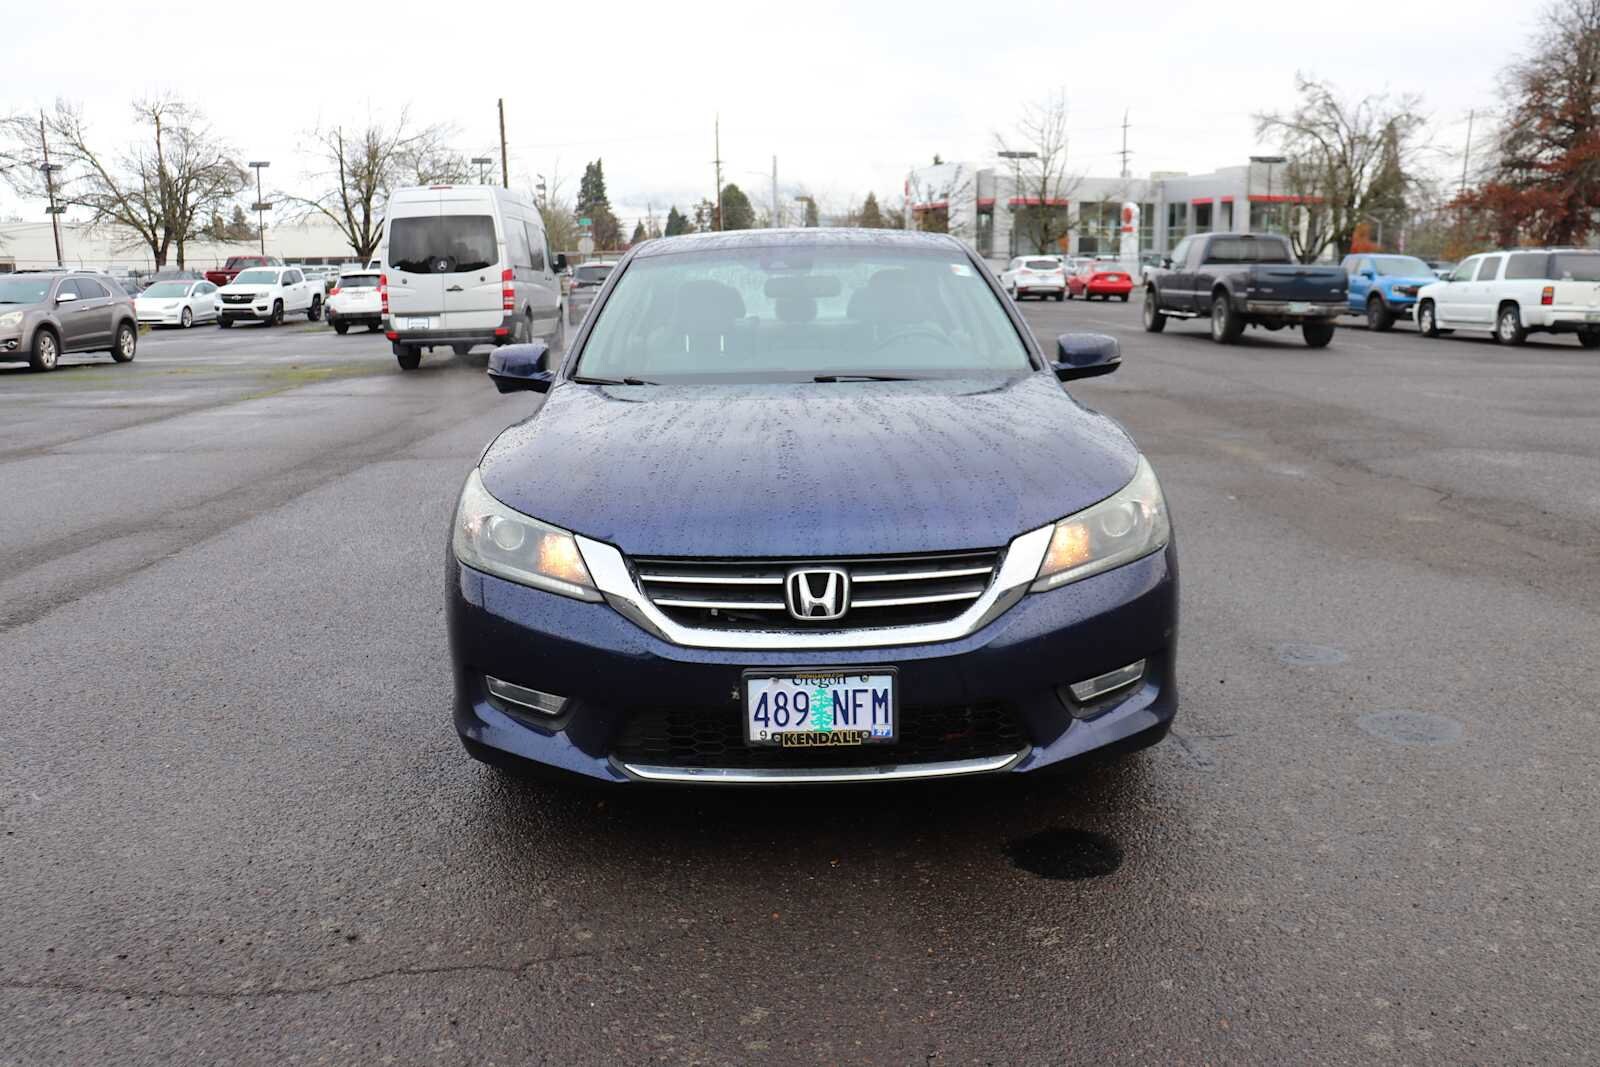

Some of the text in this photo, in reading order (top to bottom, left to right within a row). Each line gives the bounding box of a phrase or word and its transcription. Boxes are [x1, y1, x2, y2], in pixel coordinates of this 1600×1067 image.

[753, 688, 889, 728] 489 NFM
[783, 731, 861, 746] KENDALL
